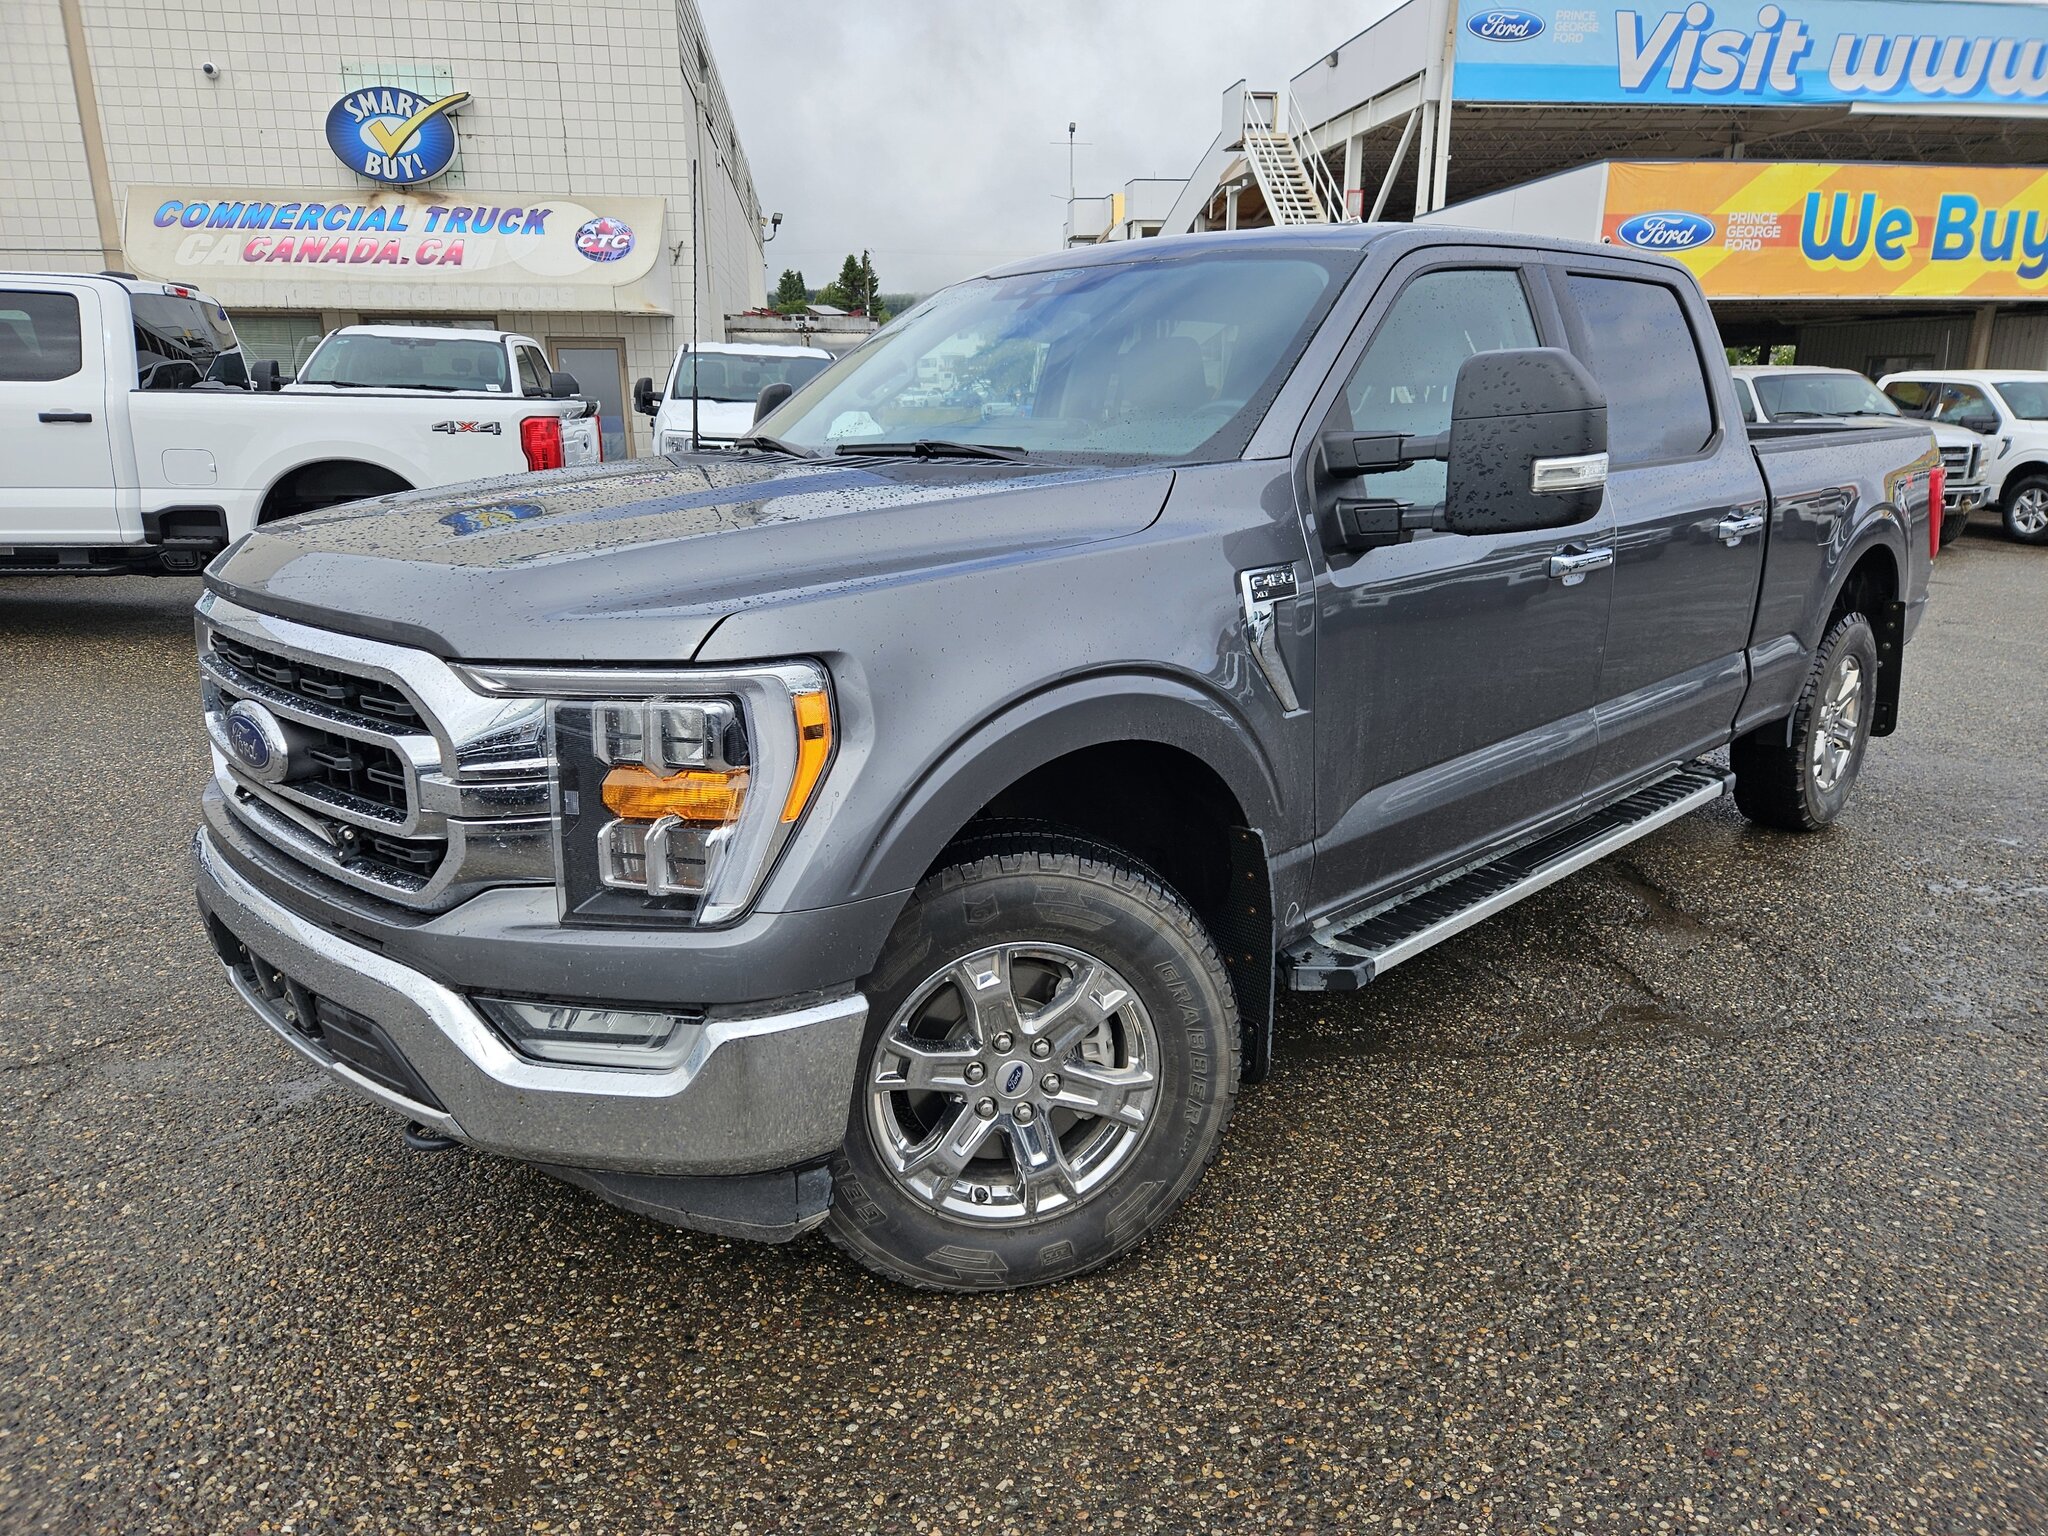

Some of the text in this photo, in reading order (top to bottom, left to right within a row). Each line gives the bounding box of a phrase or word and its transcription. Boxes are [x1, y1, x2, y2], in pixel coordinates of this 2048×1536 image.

[1481, 12, 1530, 37] Ford
[1553, 22, 1600, 32] GEORGE
[1555, 10, 1597, 21] PRINCE
[1552, 33, 1584, 43] FORD
[1615, 2, 1810, 94] Visit
[343, 90, 430, 124] SMART
[364, 151, 427, 180] BUY!
[153, 199, 553, 235] COMMERCIAL TRUCK
[1636, 216, 1697, 245] Ford
[1726, 225, 1782, 238] GEORGE
[1727, 212, 1778, 225] PRINCE
[577, 233, 630, 249] CTC
[1724, 238, 1762, 251] FORD
[1801, 190, 2048, 280] We Buy
[242, 236, 465, 266] CANADA.CA
[231, 721, 258, 760] Ford
[1153, 960, 1209, 1125] GRABBER
